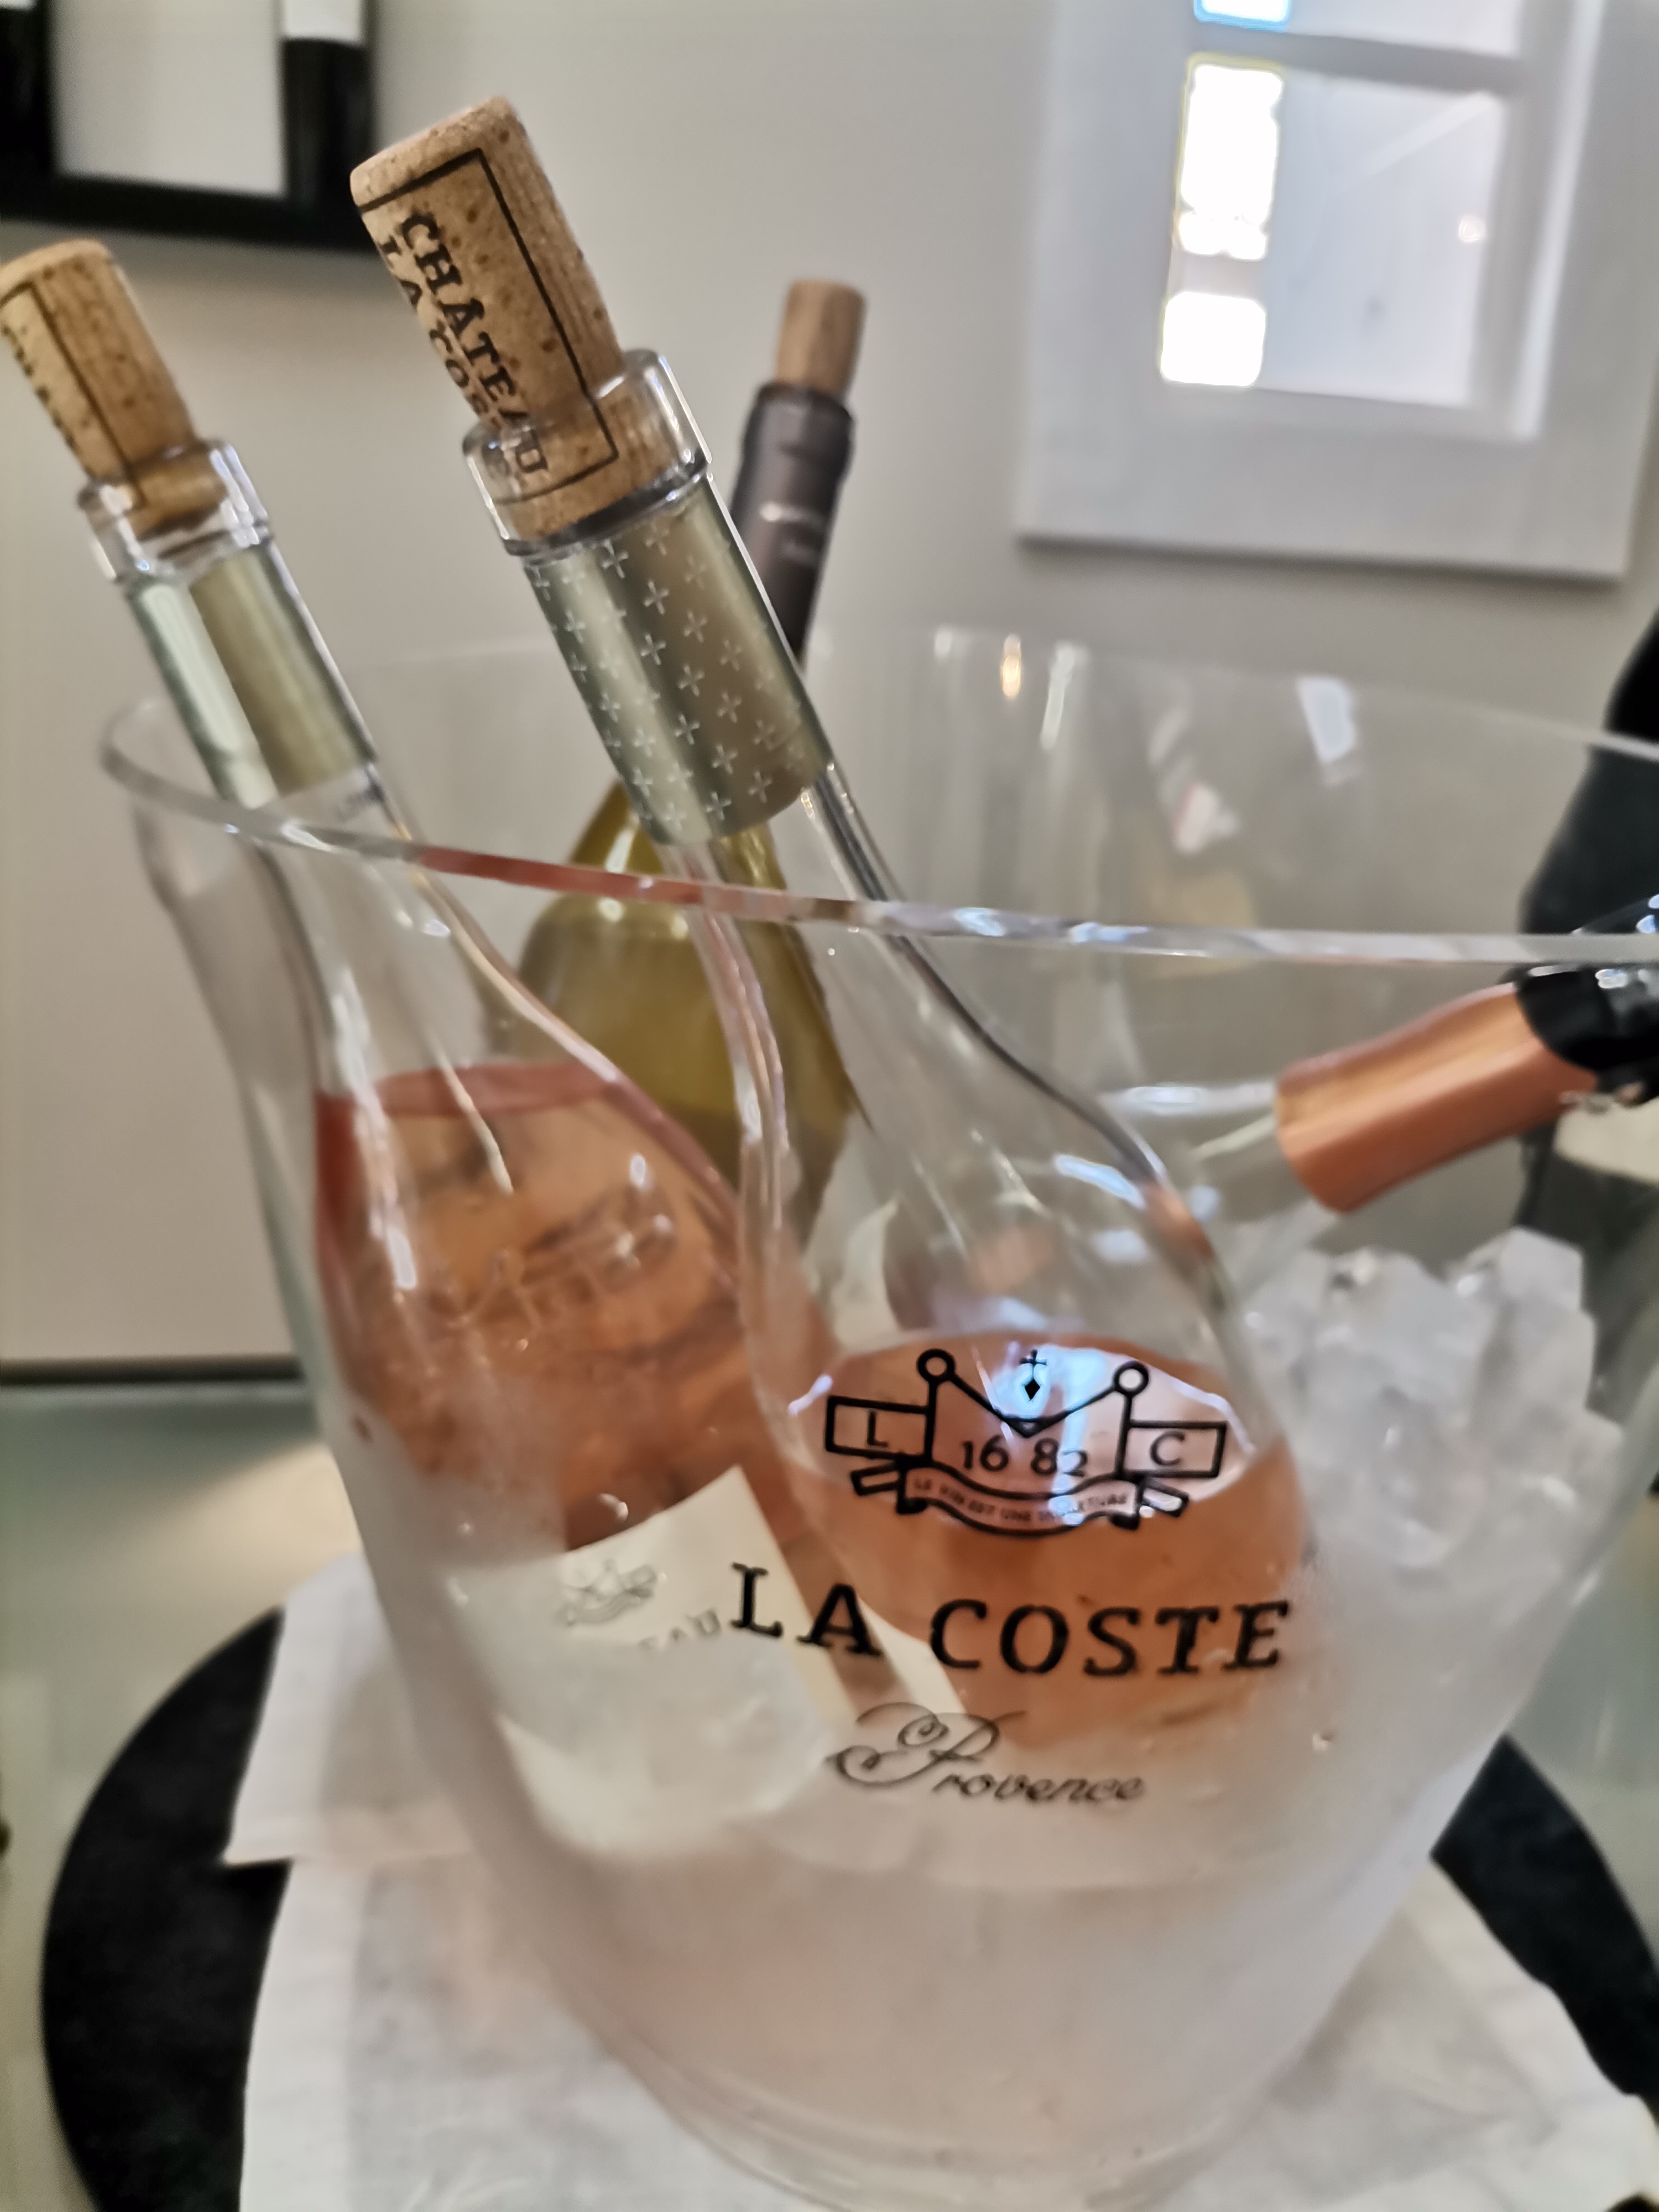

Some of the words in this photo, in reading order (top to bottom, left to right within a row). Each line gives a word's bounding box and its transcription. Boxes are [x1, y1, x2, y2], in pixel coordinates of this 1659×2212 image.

[866, 1410, 888, 1448] L
[1149, 1431, 1186, 1466] C
[731, 1561, 883, 1657] LA
[928, 1599, 1290, 1678] COSTE
[824, 1701, 1146, 1805] Provence
